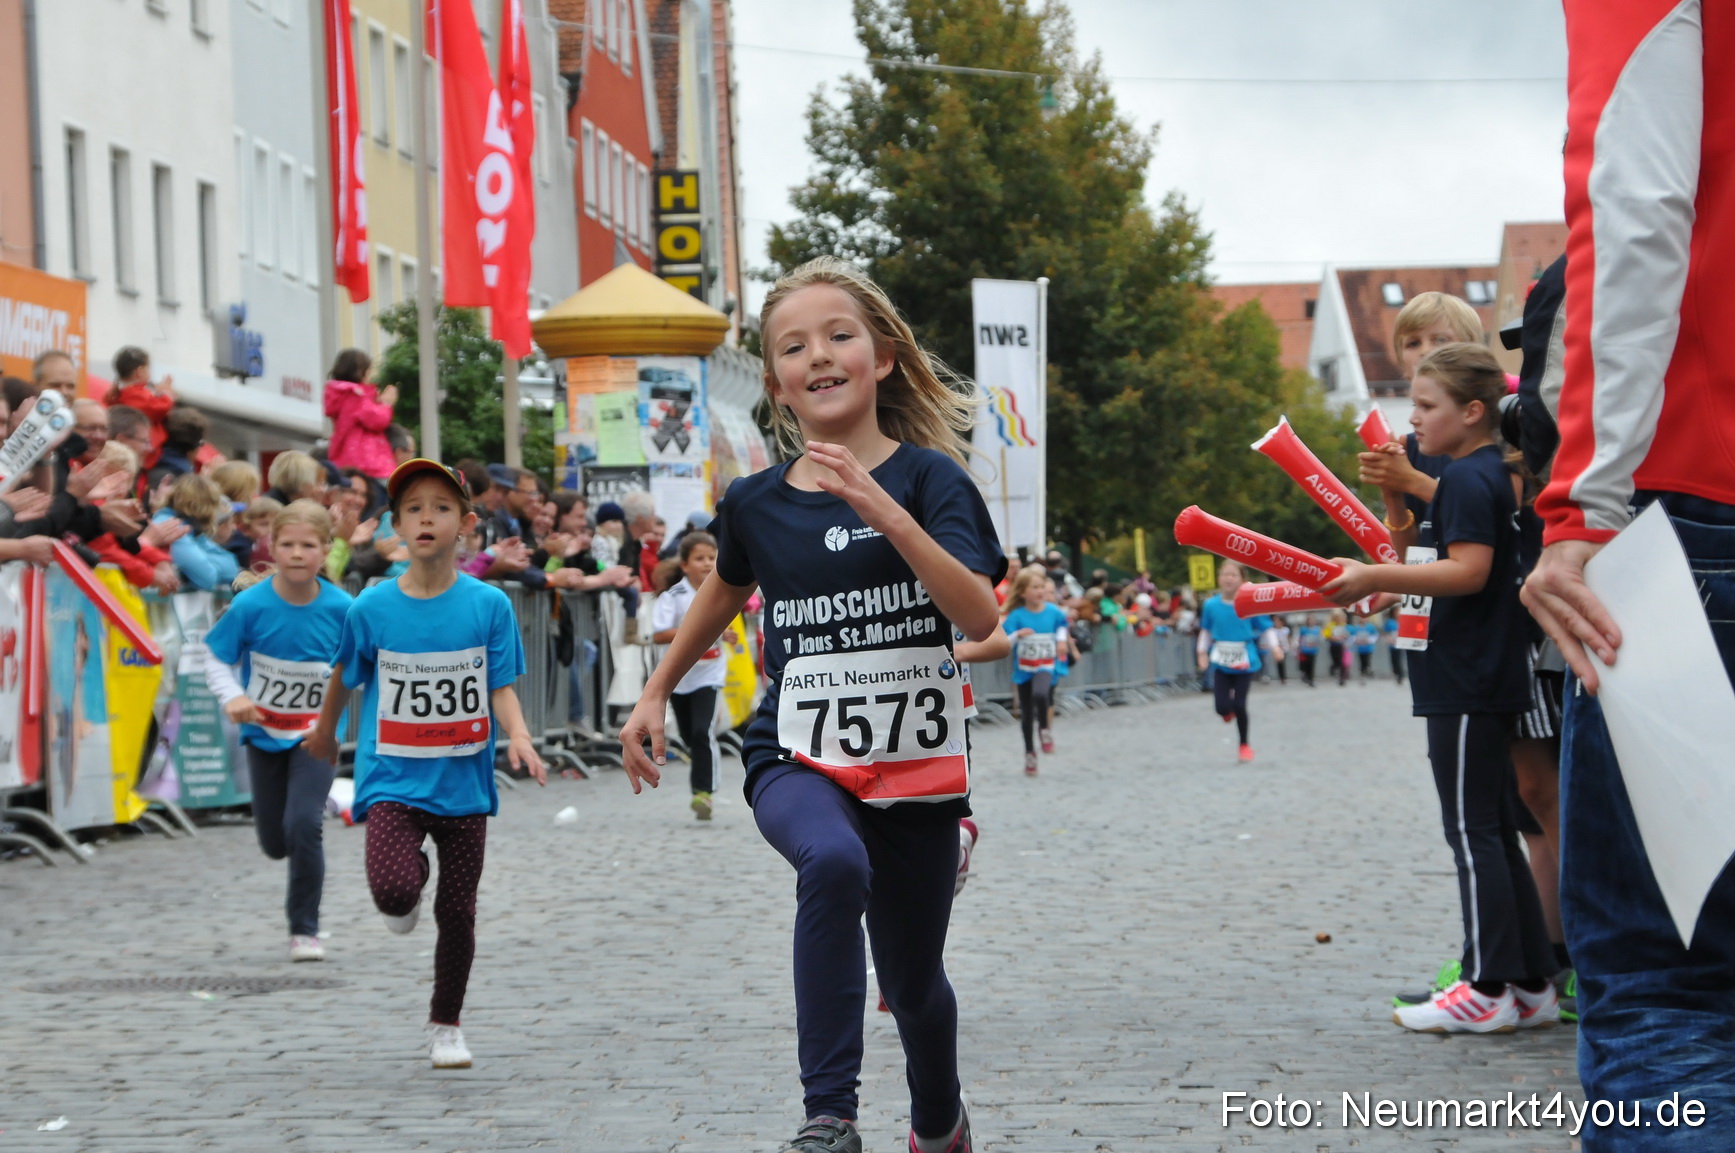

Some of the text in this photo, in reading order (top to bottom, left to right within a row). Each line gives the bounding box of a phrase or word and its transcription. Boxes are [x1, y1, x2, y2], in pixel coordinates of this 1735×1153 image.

[1306, 473, 1371, 537] Audi BKK
[1268, 549, 1328, 582] Audi BKK
[277, 669, 318, 678] Neumarkt
[380, 661, 470, 674] PARTL Neumarkt
[784, 665, 931, 692] PARTL Neumarkt
[258, 673, 323, 709] 7226
[388, 675, 480, 718] 7536
[796, 687, 949, 759] 7573
